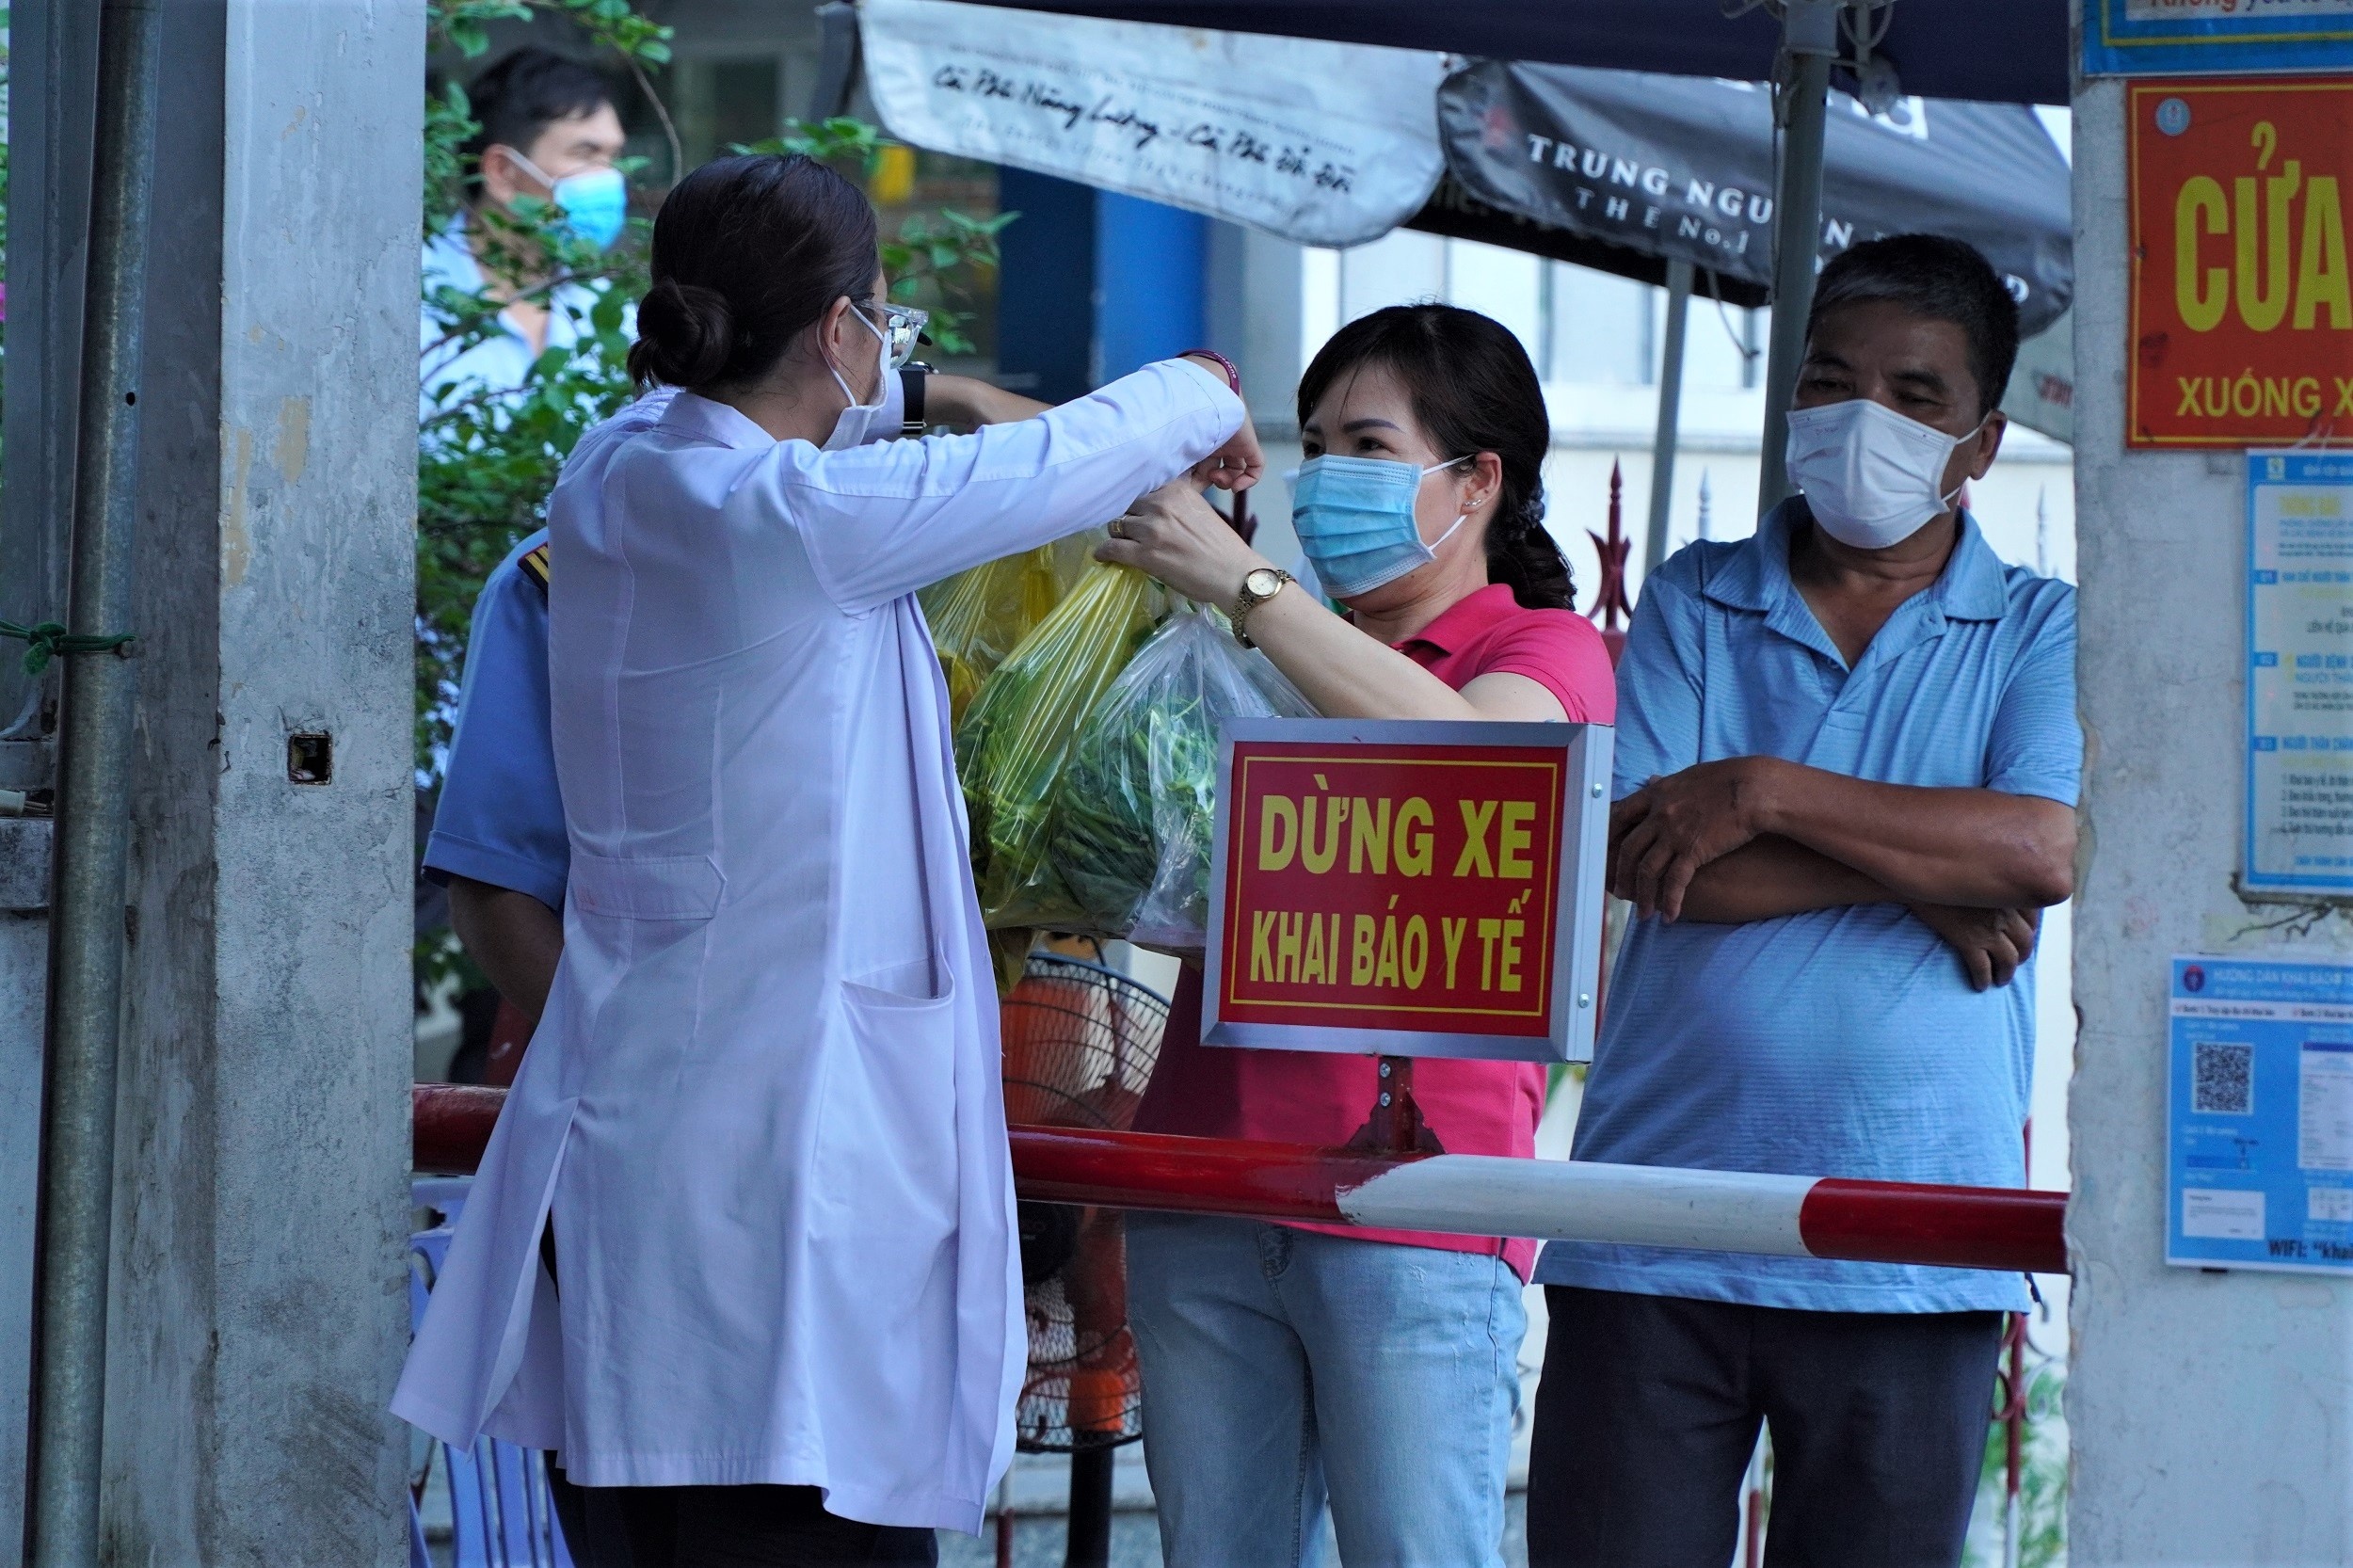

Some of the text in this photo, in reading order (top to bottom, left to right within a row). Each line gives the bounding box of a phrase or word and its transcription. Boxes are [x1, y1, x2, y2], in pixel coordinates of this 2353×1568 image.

[1527, 134, 1669, 196] TRUNG
[1576, 185, 1750, 254] THE No.1
[2175, 120, 2353, 332] CỬA
[2176, 367, 2322, 418] XUỐNG
[1258, 774, 1536, 879] DỪNG XE
[1250, 888, 1532, 993] KHAI BÁO Y TẾ
